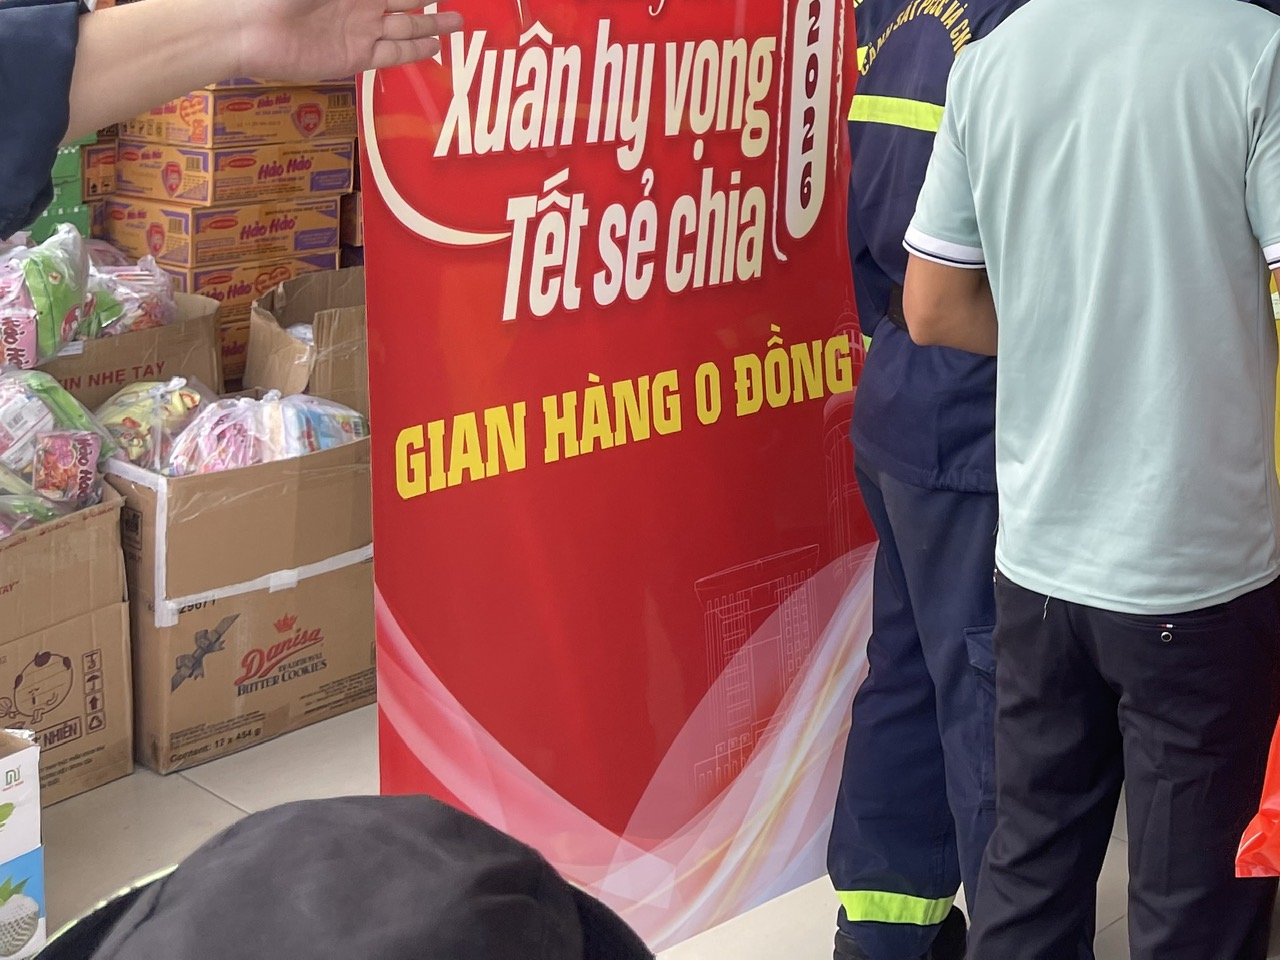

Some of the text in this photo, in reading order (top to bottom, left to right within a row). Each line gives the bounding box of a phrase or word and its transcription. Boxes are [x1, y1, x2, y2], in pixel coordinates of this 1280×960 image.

[940, 0, 969, 30] VÀ
[434, 19, 777, 172] Xuân hy vọng
[799, 0, 822, 210] 2026
[258, 155, 312, 180] Hảo Hảo
[240, 215, 295, 240] Hảo Hảo
[502, 168, 767, 321] Tết sẻ chia
[227, 280, 252, 300] Hảo
[88, 361, 165, 393] NHẸ TAY
[395, 401, 526, 500] GIAN
[542, 374, 682, 464] HÀNG
[734, 323, 852, 418] ĐỒNG
[233, 627, 324, 686] Danisa
[236, 675, 279, 697] BUTTER
[281, 658, 328, 684] COOKIES
